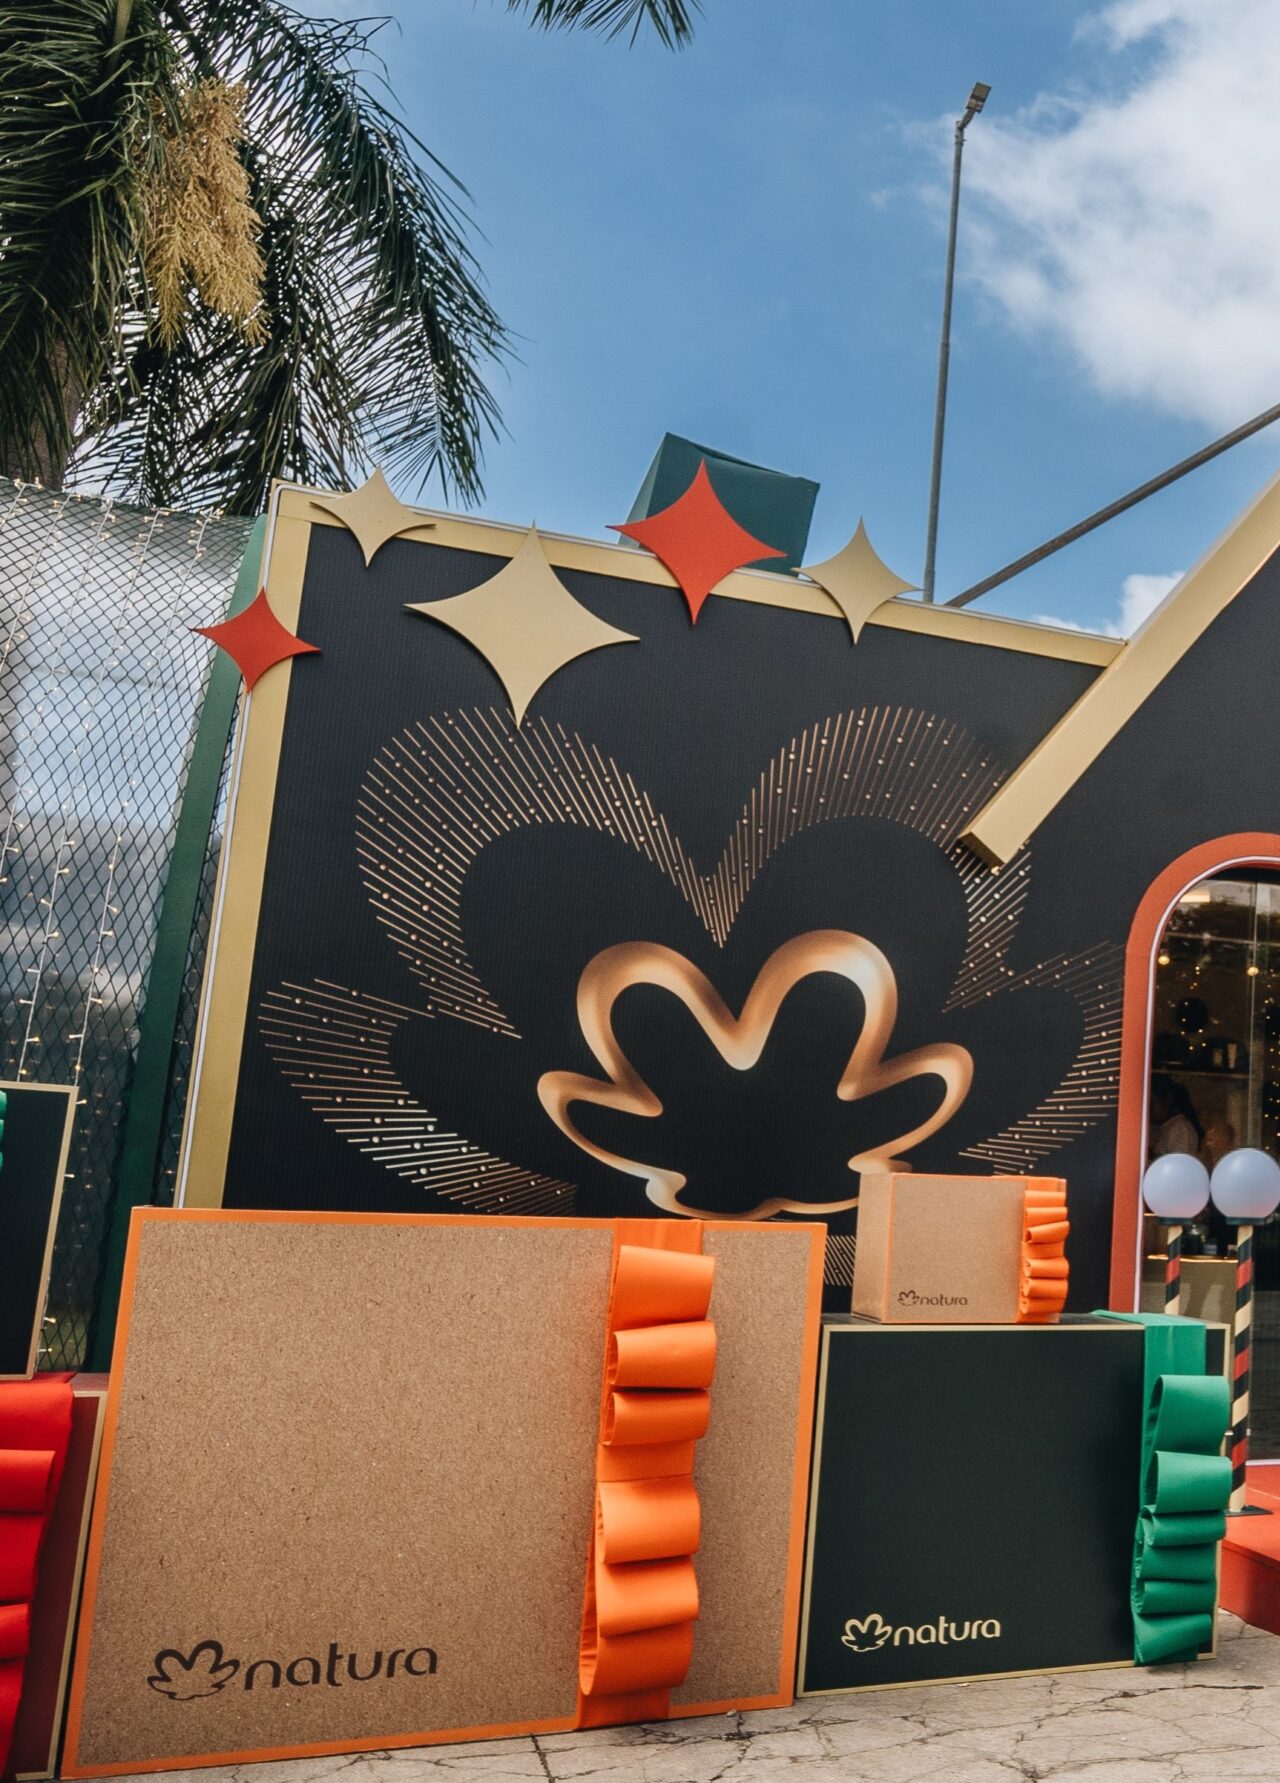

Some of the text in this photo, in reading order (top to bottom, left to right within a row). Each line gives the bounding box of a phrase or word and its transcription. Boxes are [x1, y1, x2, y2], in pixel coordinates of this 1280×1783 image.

[920, 1294, 967, 1306] natura
[894, 1616, 1000, 1646] natura
[244, 1643, 437, 1690] natura
